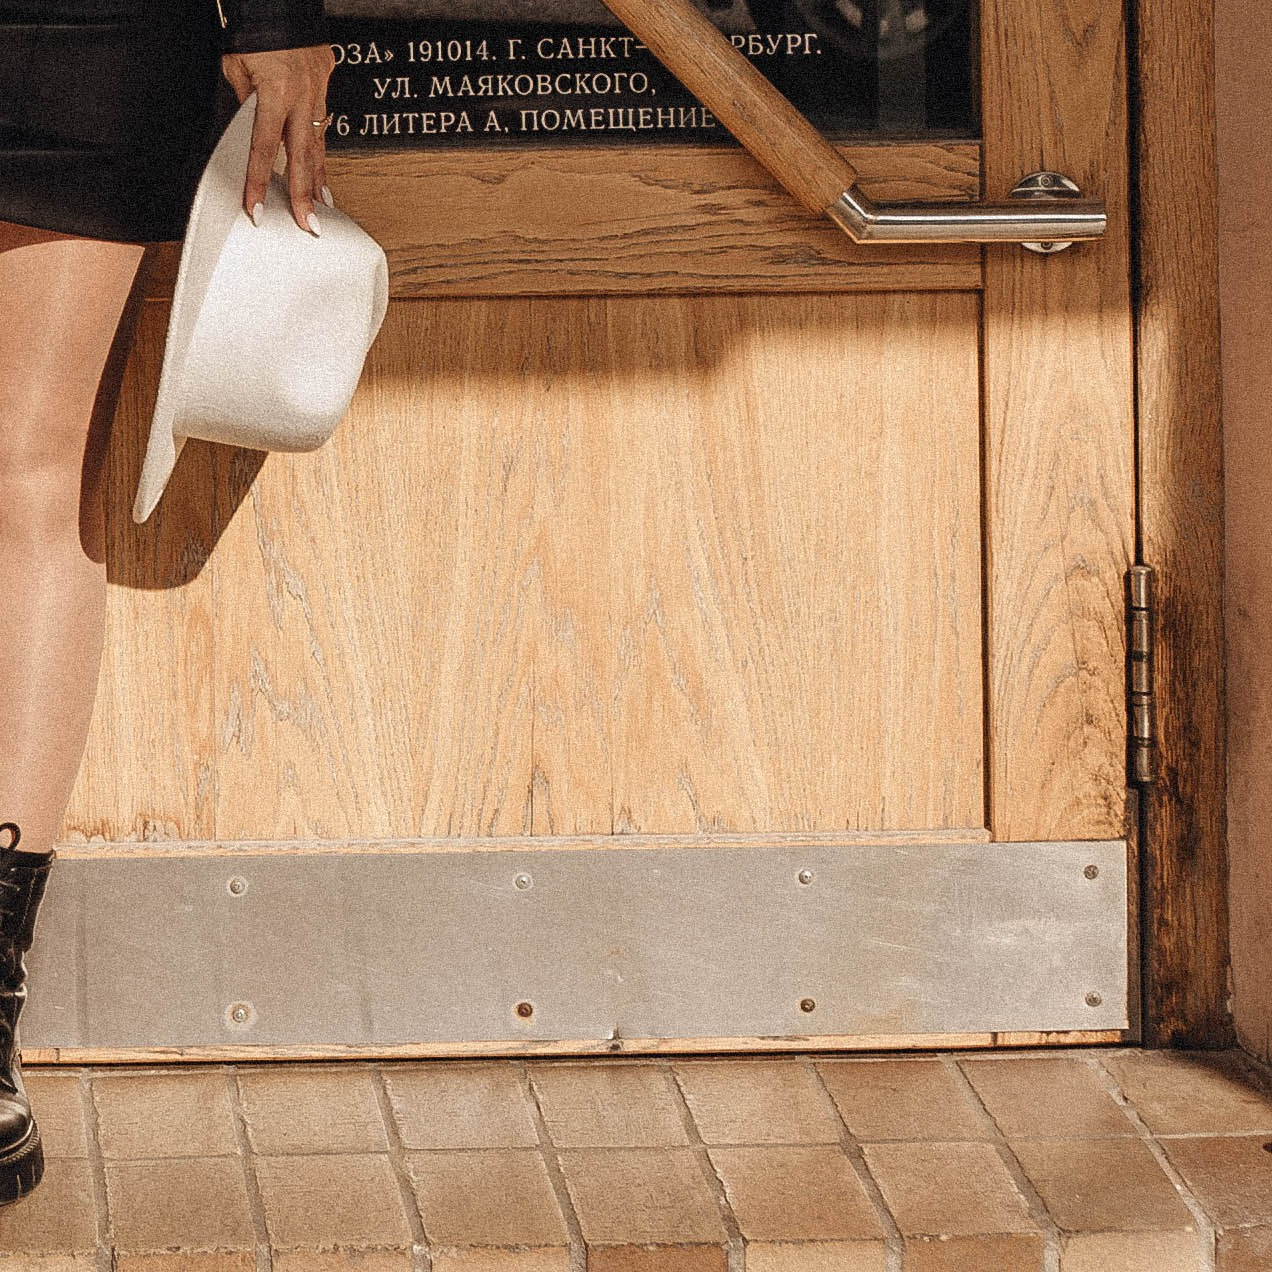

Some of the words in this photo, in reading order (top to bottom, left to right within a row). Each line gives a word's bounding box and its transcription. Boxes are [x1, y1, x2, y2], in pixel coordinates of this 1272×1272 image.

[330, 42, 394, 65] ОЗА»
[408, 39, 497, 62] 191014.
[508, 38, 526, 60] Г.
[373, 77, 418, 99] УЛ.
[428, 72, 657, 98] МАЯКОВСКОГО,
[359, 111, 474, 136] ЛИТЕРА
[519, 106, 716, 133] ПОМЕЩЕНИЕ
